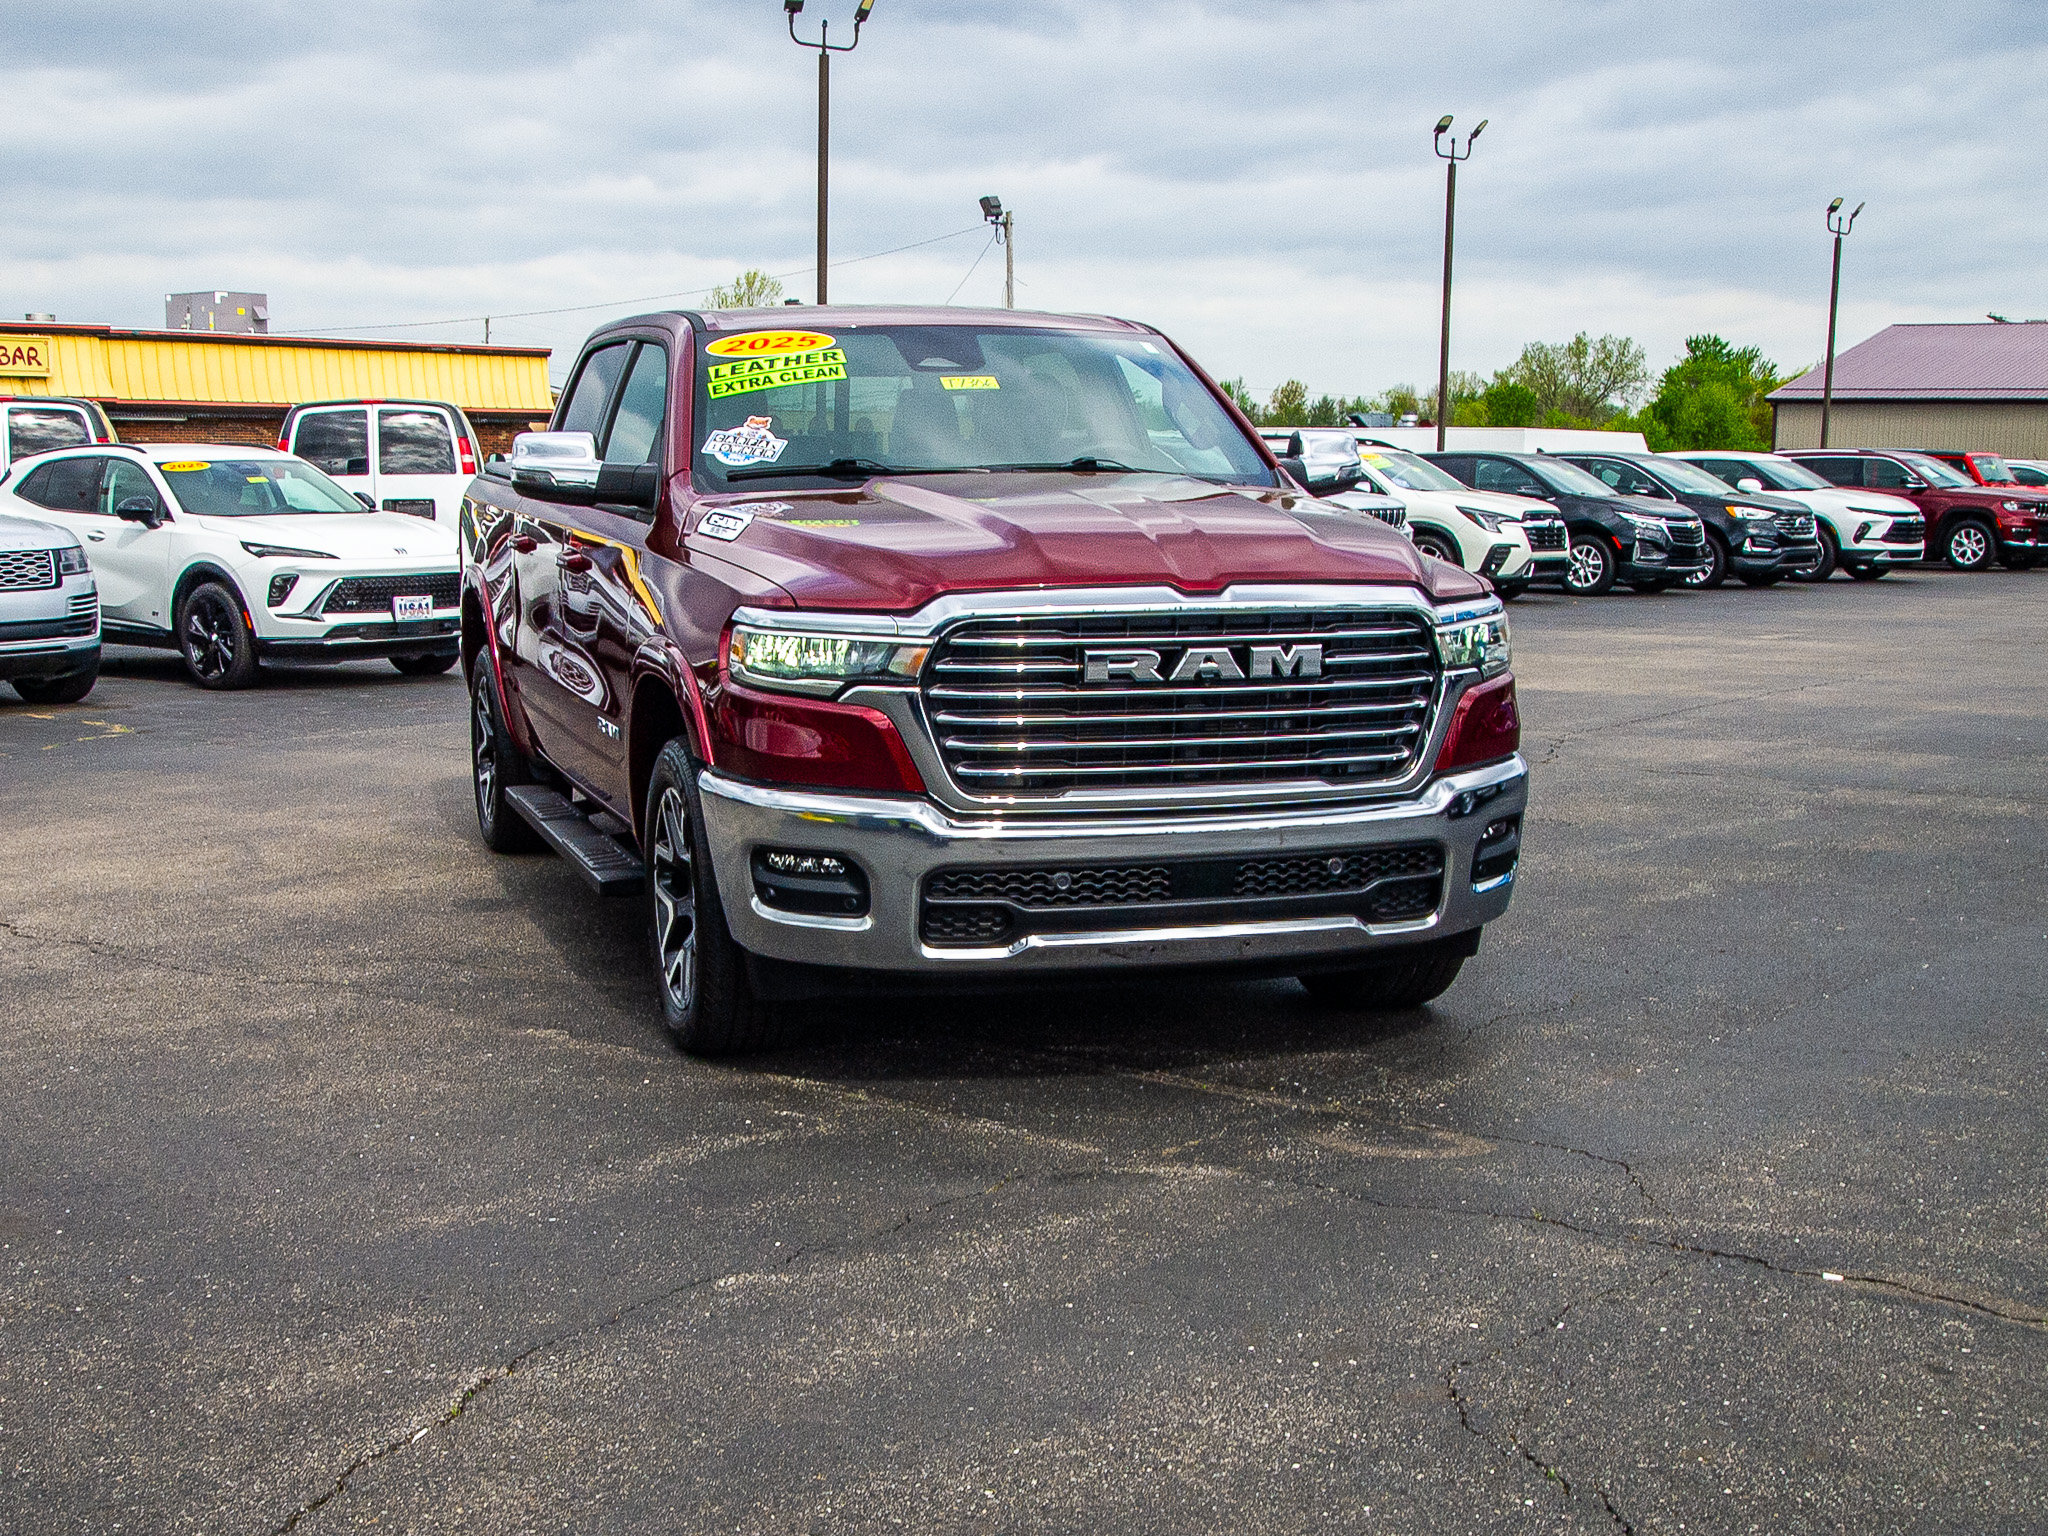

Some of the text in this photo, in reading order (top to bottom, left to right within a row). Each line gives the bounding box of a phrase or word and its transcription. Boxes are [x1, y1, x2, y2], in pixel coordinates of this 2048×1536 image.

[721, 335, 820, 353] 2025
[0, 345, 43, 367] BAR
[714, 351, 839, 379] LEATHER
[712, 366, 839, 395] EXTRA CLEAN
[168, 462, 205, 471] 2025
[398, 601, 431, 616] USA1
[1083, 643, 1323, 683] RAM
